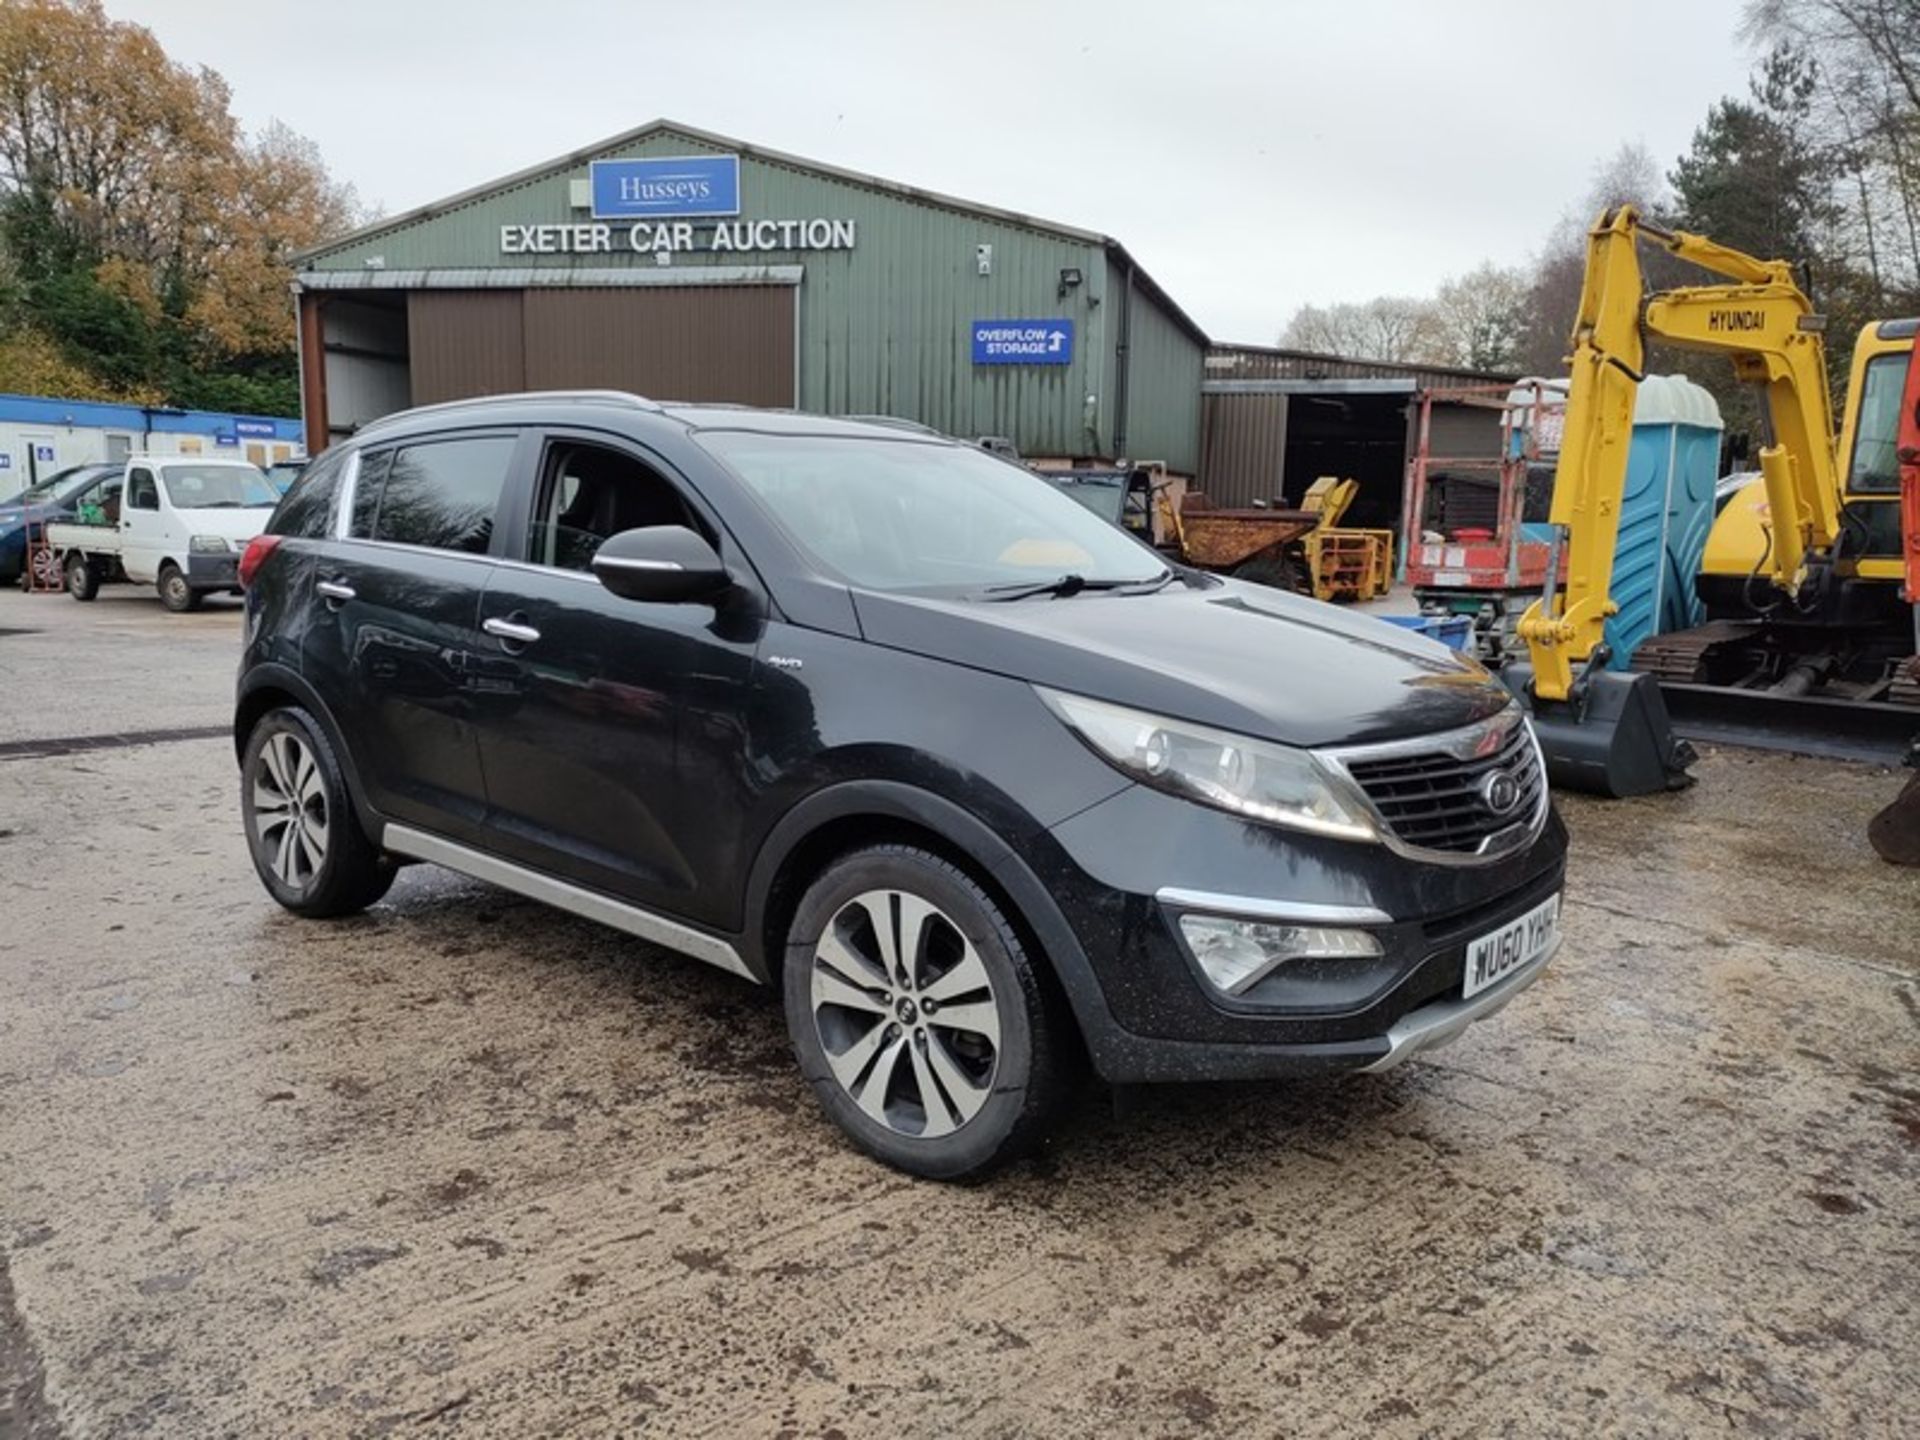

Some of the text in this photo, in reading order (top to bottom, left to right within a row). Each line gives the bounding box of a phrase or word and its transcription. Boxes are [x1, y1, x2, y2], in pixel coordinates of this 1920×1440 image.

[620, 176, 710, 204] Husseys
[501, 218, 855, 252] EXETER CAR AUCTION
[1708, 310, 1765, 331] HYUNDAI
[976, 328, 1047, 342] OVERFLOW
[986, 342, 1046, 354] STORAGE
[1474, 923, 1523, 987] WU60
